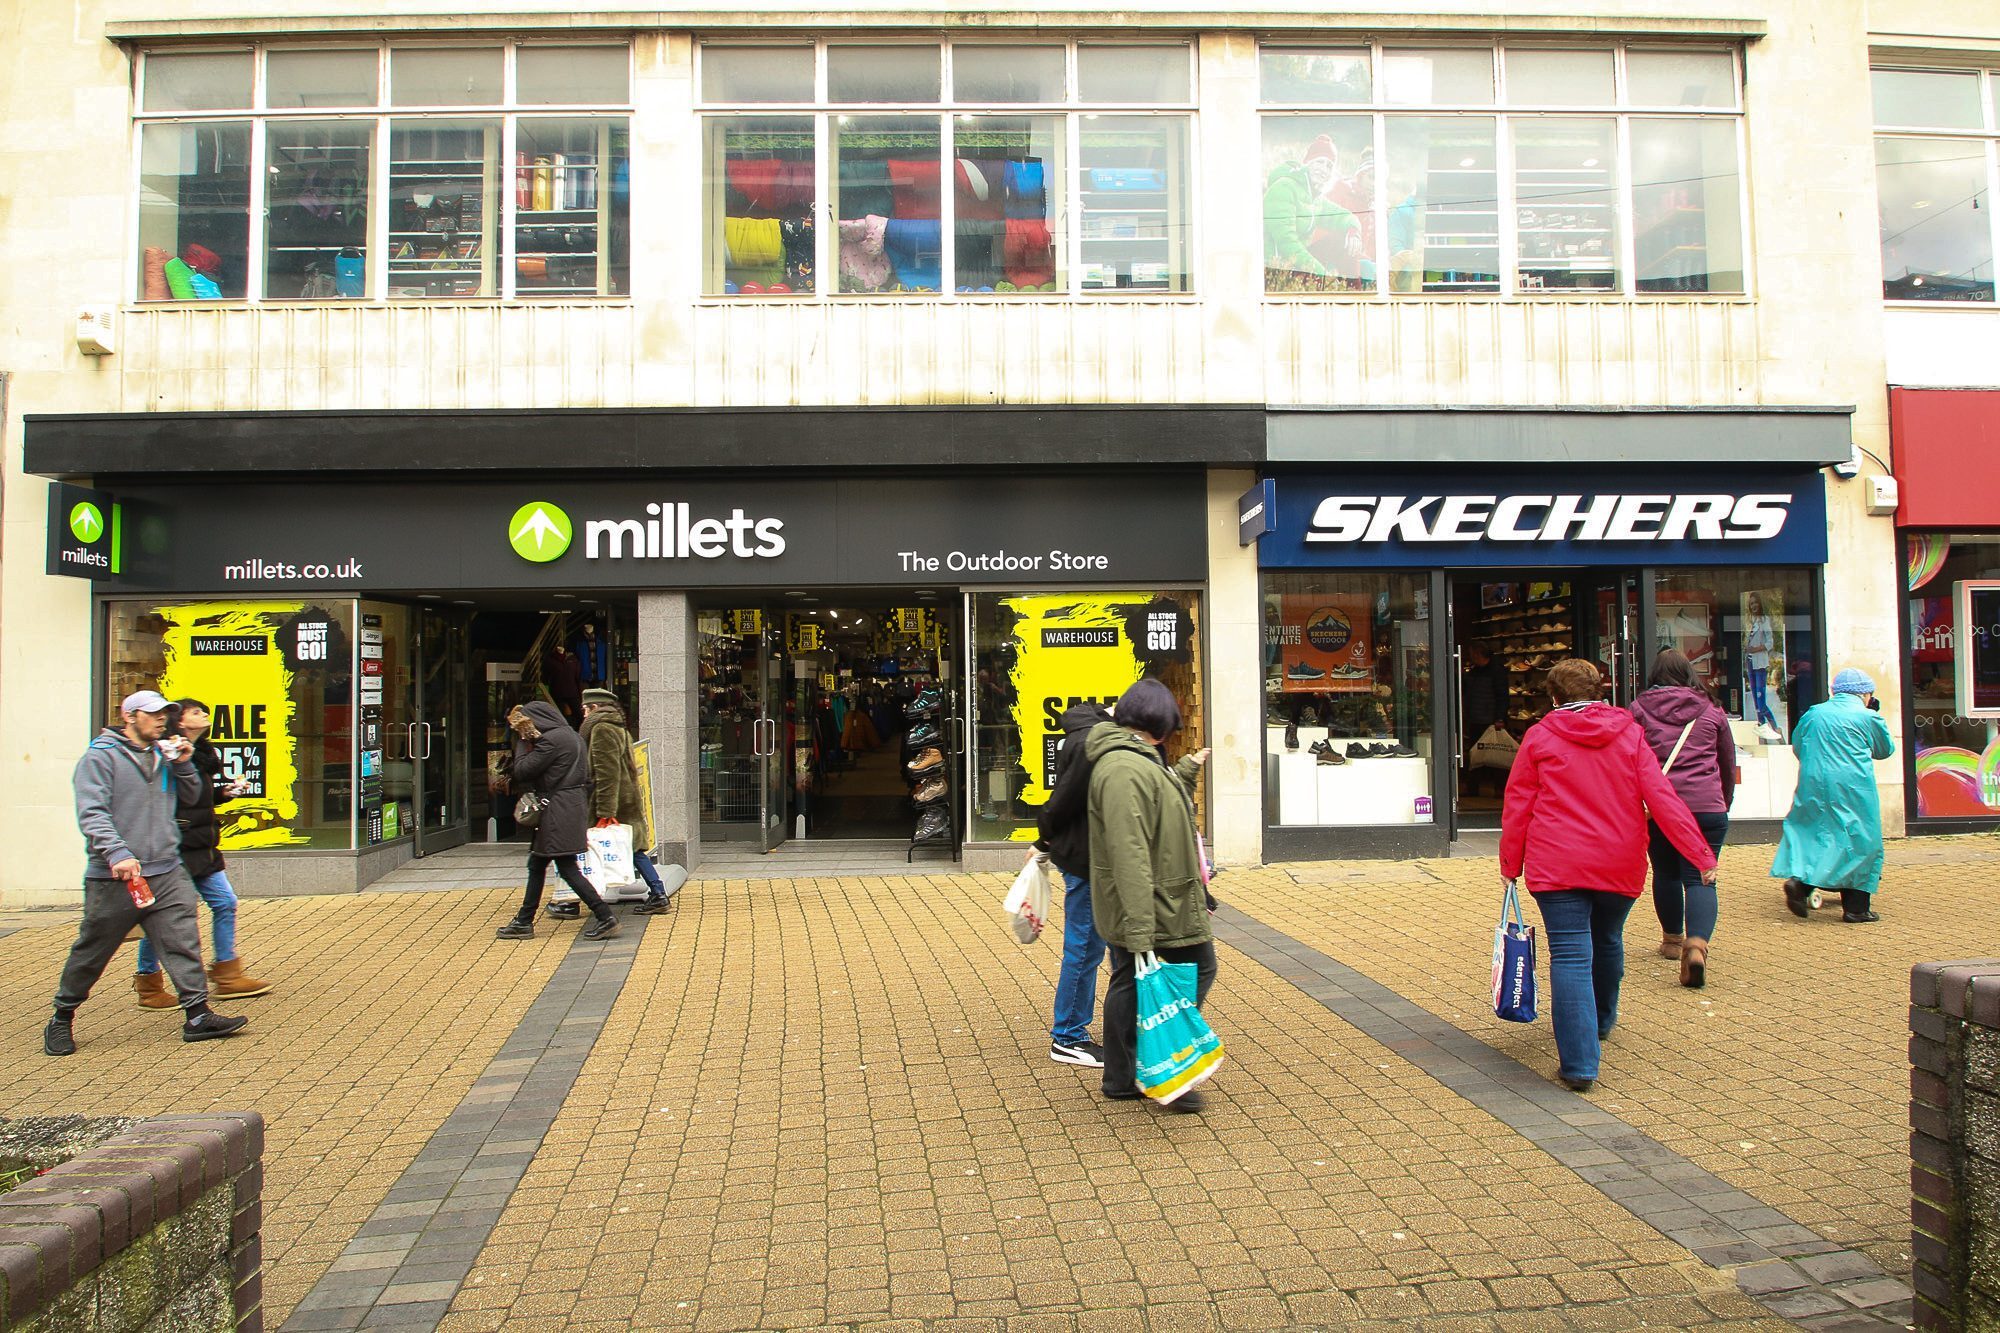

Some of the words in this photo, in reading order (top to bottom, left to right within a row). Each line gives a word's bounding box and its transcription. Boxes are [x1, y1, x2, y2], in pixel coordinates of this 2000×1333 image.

[1304, 493, 1794, 542] SKECHERS
[585, 502, 786, 559] millets
[62, 547, 108, 567] millets
[897, 552, 940, 572] The
[946, 550, 1043, 572] Outdoor
[1049, 550, 1109, 571] Store
[225, 557, 363, 580] millets.co.uk
[1147, 612, 1158, 620] ALL
[1158, 612, 1177, 620] STOCK
[1147, 620, 1177, 631] MUST
[297, 629, 328, 641] MUST
[1045, 631, 1115, 644] WAREHOUSE
[1147, 631, 1177, 650] GO!
[194, 639, 264, 652] WAREHOUSE
[297, 641, 327, 660] GO!
[211, 704, 267, 739] ALE
[1047, 739, 1055, 760] LEAST
[1047, 761, 1055, 771] AT
[1516, 956, 1525, 979] eden
[1512, 978, 1523, 1009] project
